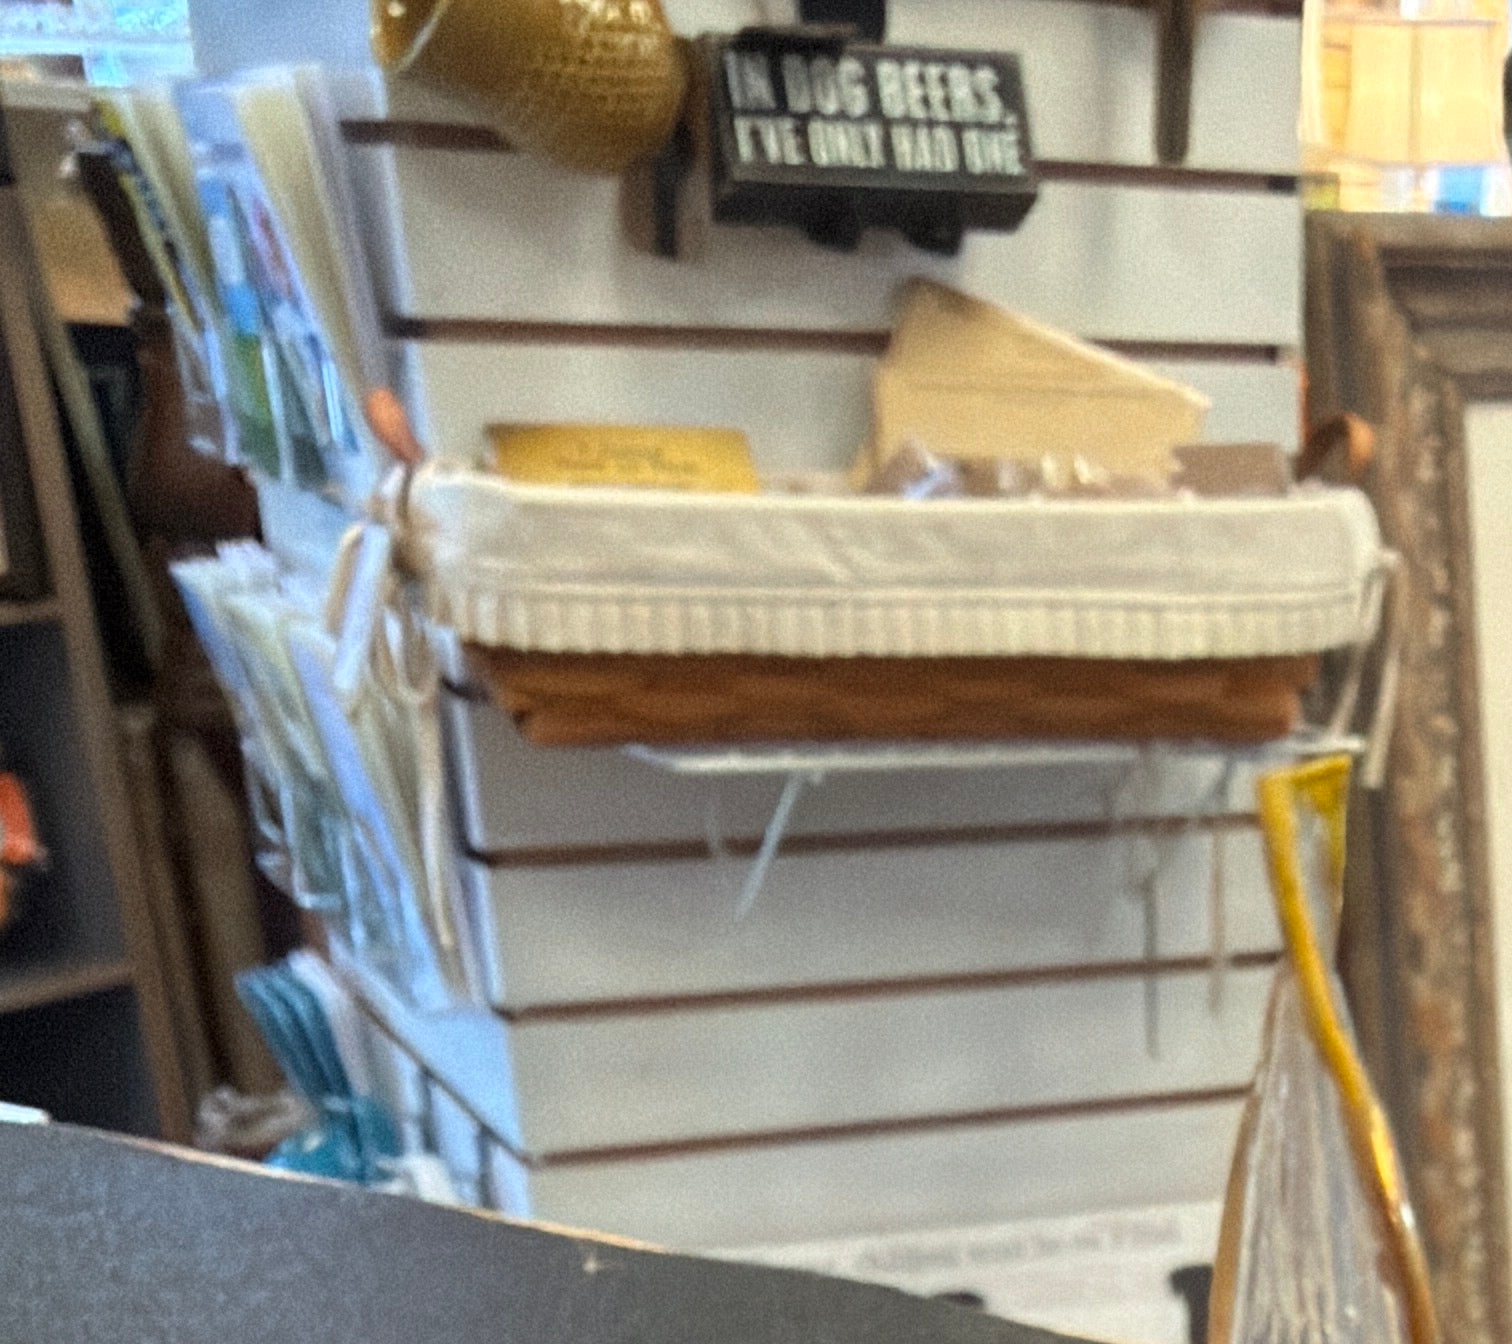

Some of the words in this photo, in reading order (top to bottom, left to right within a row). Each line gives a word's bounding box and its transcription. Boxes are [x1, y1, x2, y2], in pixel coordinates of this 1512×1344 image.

[724, 51, 776, 110] IN
[782, 54, 869, 117] DOG
[807, 119, 885, 168] ONLY
[889, 124, 959, 172] HAD
